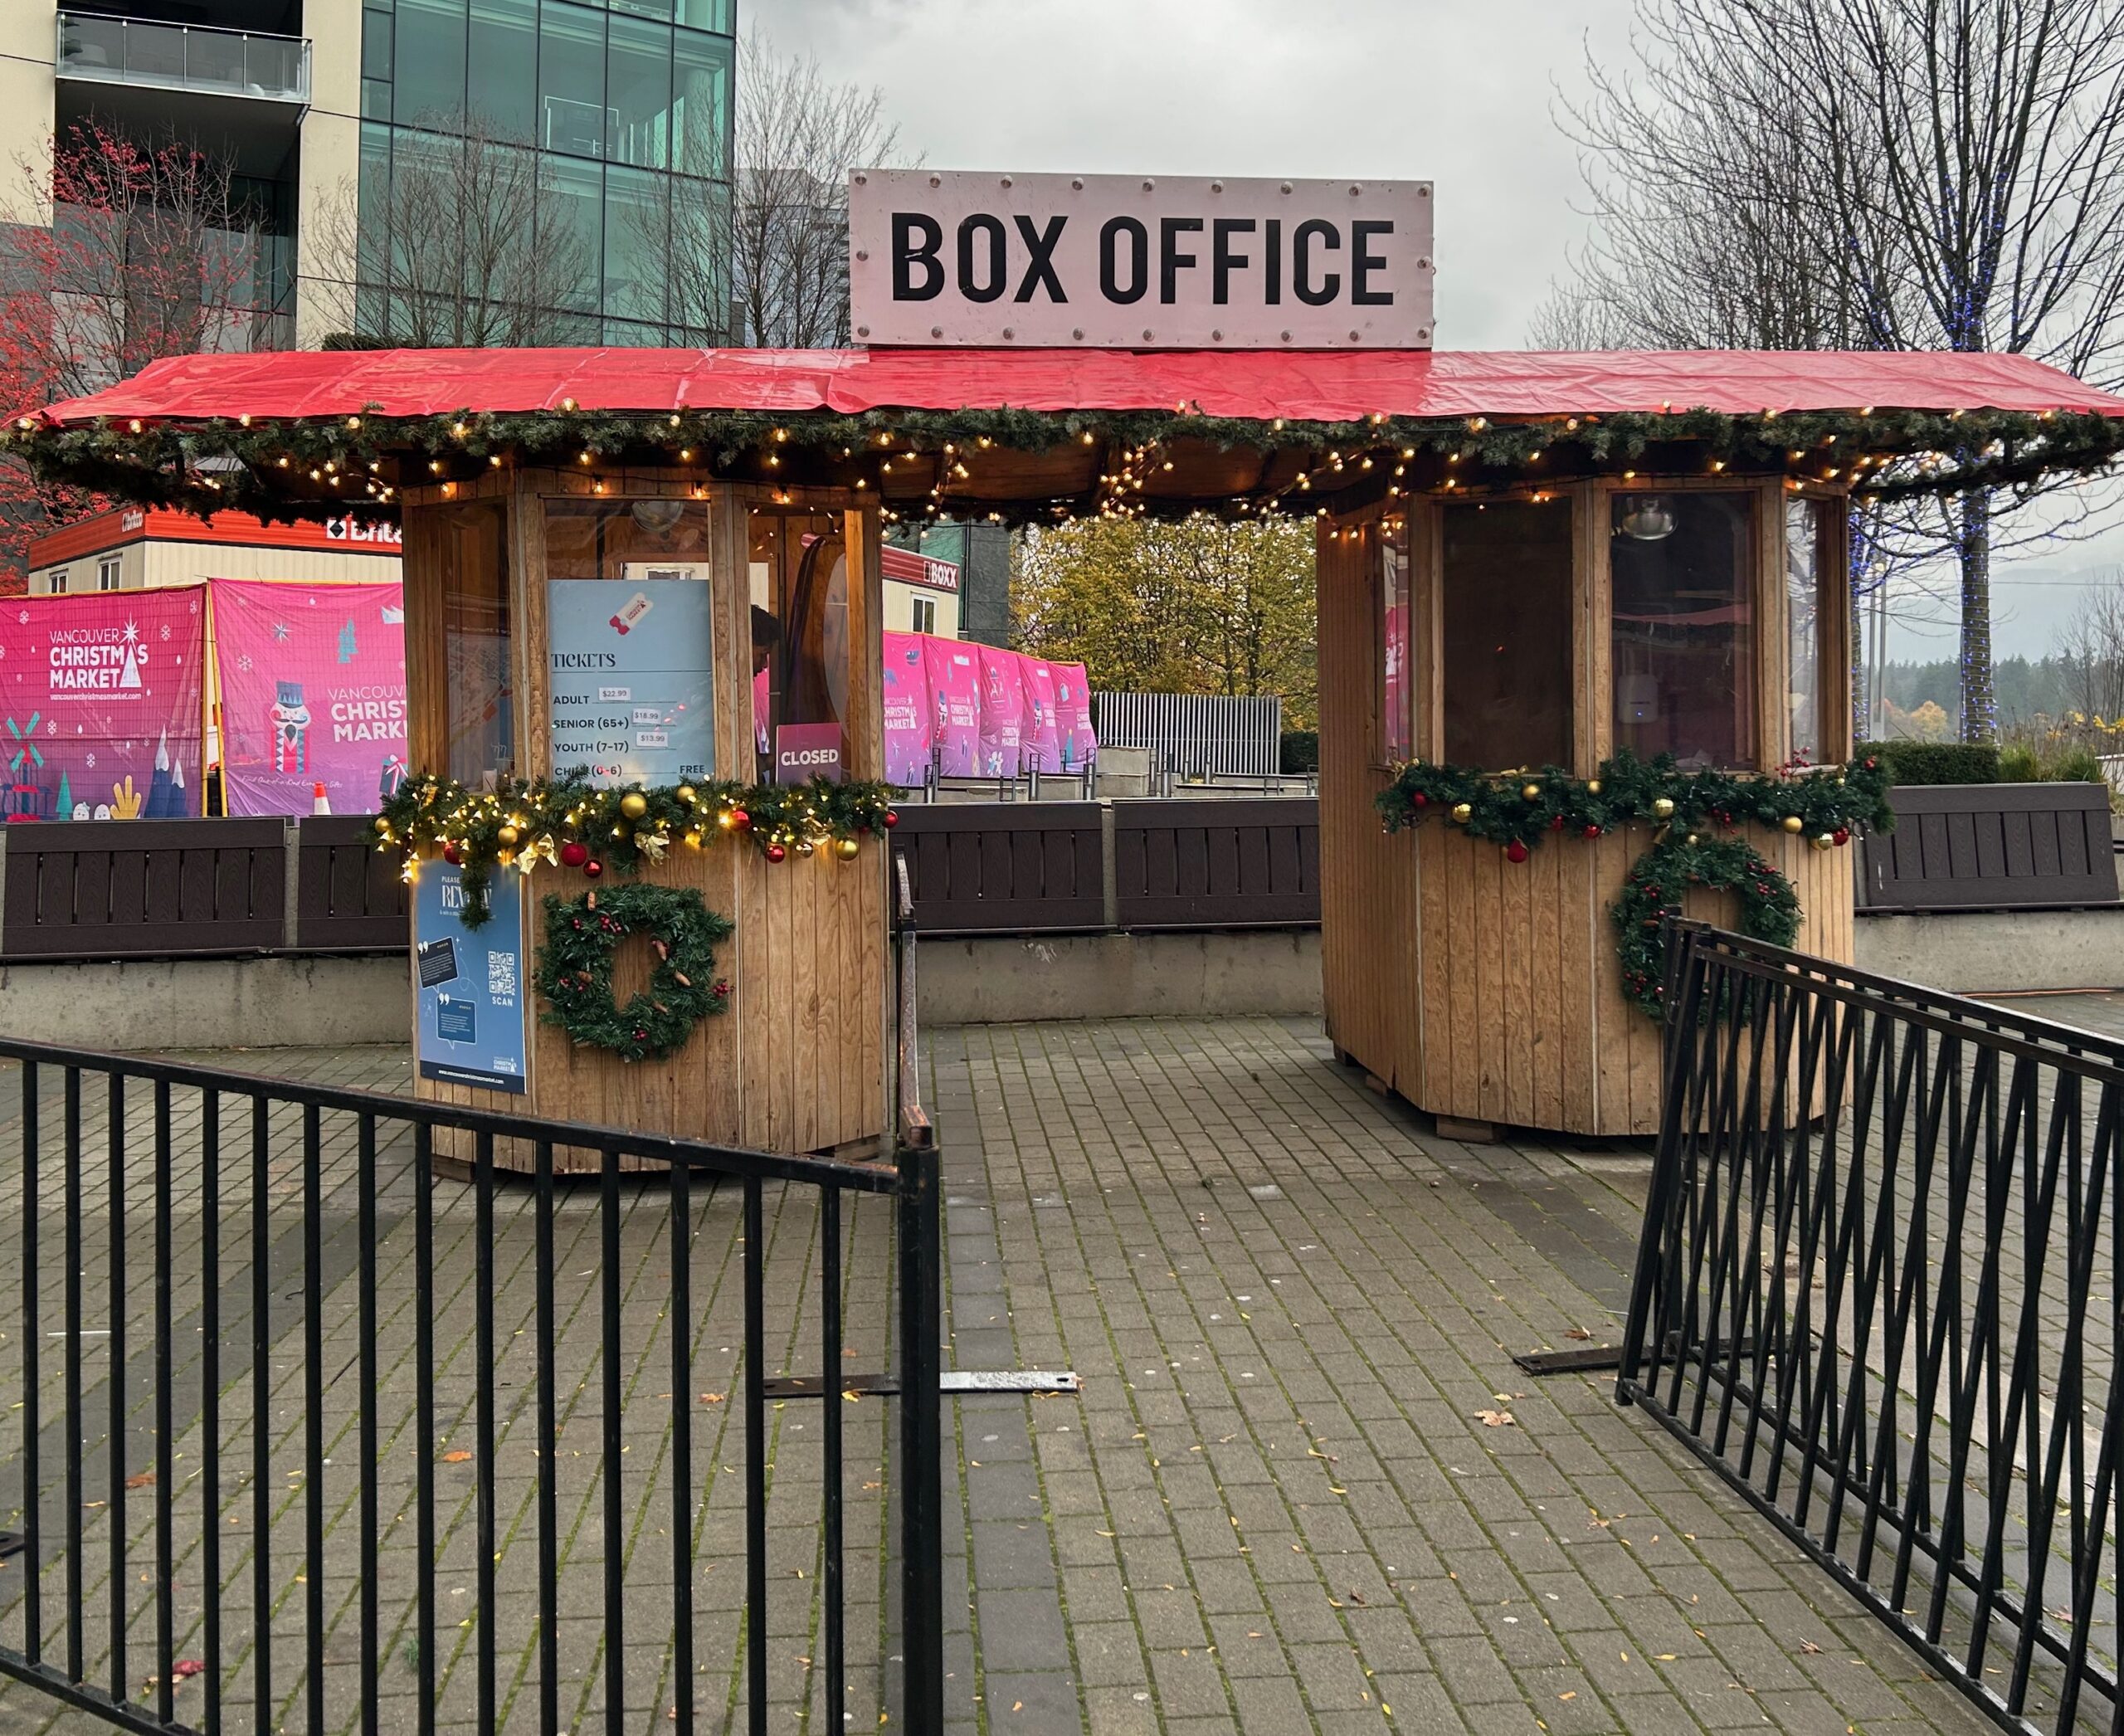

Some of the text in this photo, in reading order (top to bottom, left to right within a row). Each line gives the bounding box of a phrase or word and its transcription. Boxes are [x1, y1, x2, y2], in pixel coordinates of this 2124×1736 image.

[891, 212, 1395, 306] BOX OFFICE
[931, 562, 957, 588] BOXX
[50, 628, 119, 644] VANCOUVER
[551, 652, 616, 668] TICKETS
[50, 668, 120, 689] MARKET
[328, 685, 404, 700] VANCOUV
[602, 690, 627, 698] $22.99
[553, 695, 590, 705] ADULT
[635, 711, 658, 719] $18.99
[553, 717, 629, 730] SENIOR (65+)
[641, 734, 665, 742] $13.99
[554, 743, 593, 753] YOUTH
[781, 749, 839, 766] CLOSED
[680, 764, 705, 774] FREE
[441, 876, 460, 885] PLEASE
[492, 996, 513, 1007] SCAN
